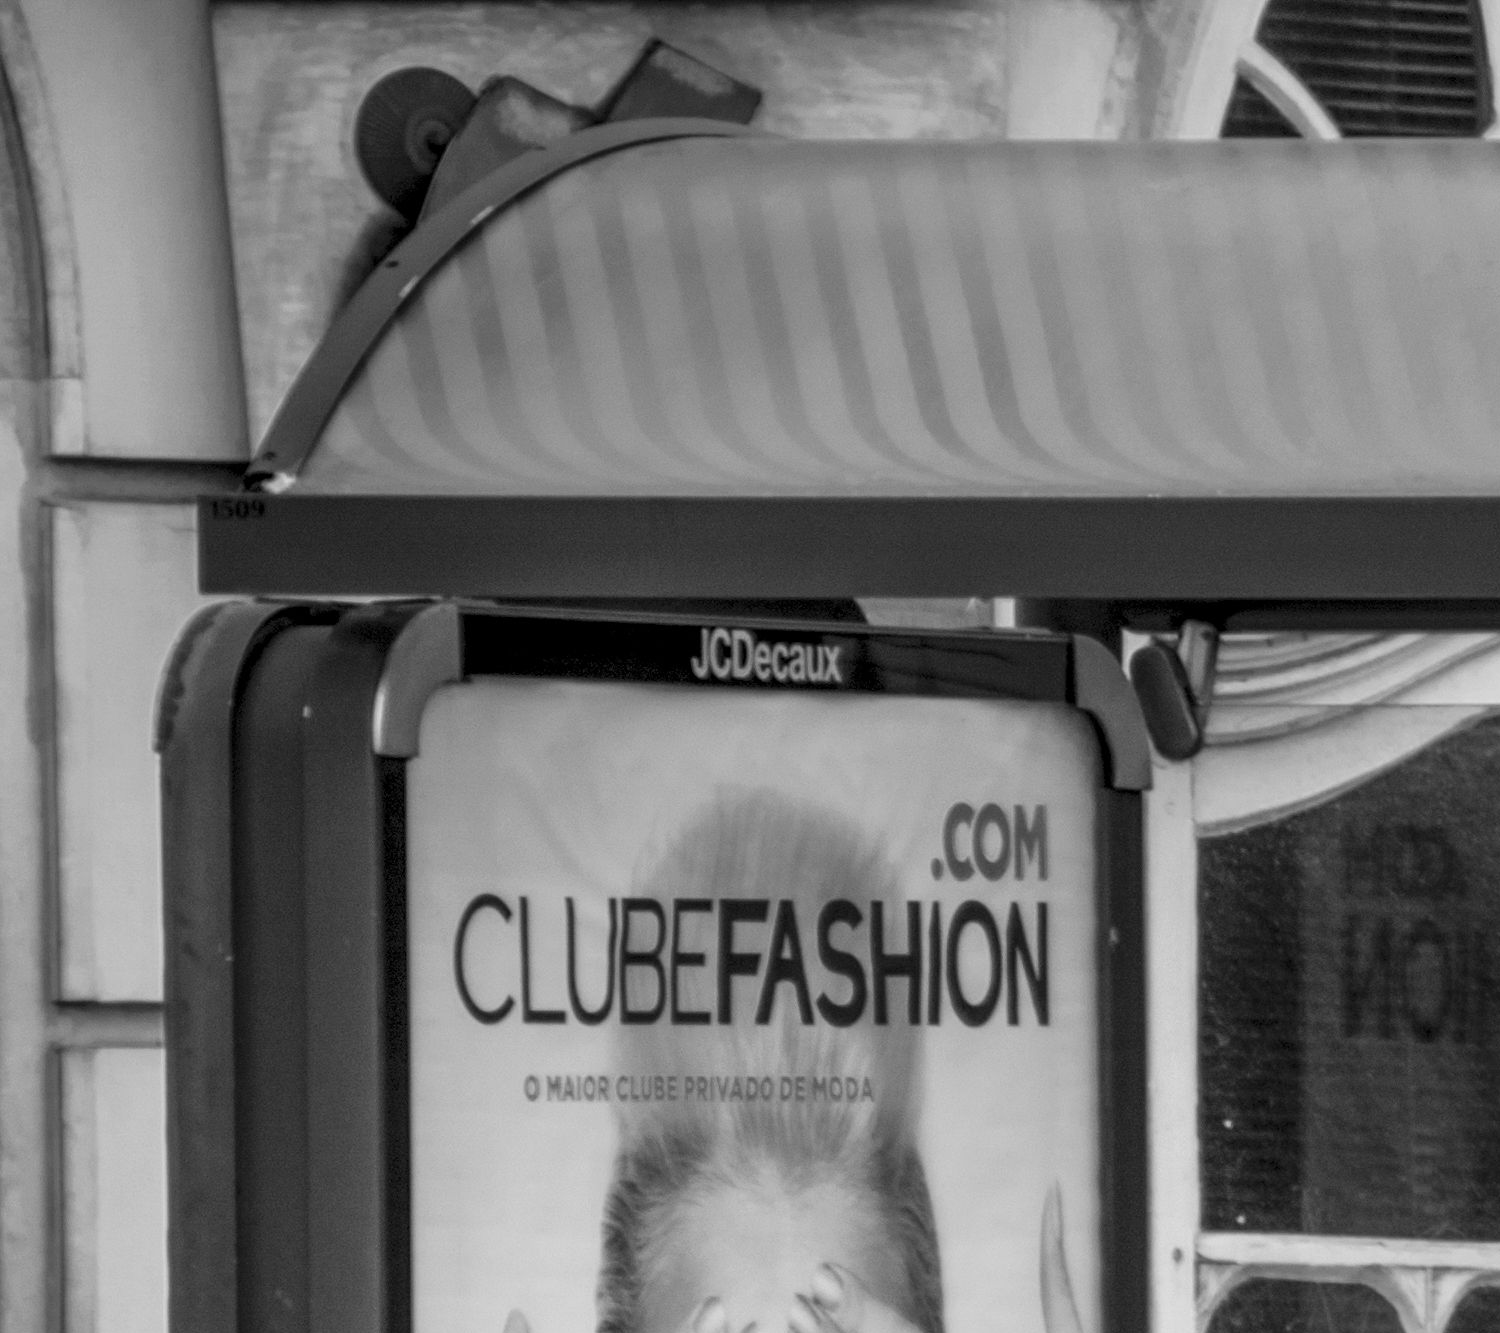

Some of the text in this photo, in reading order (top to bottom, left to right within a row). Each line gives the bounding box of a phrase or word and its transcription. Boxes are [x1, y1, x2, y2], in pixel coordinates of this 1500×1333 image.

[690, 627, 843, 683] JCDecaux
[930, 802, 1048, 882] .COM
[453, 892, 1050, 1028] CLUBEFASHION
[523, 1074, 874, 1102] O MAIOR CLUBE PRIVADO DE MODA
